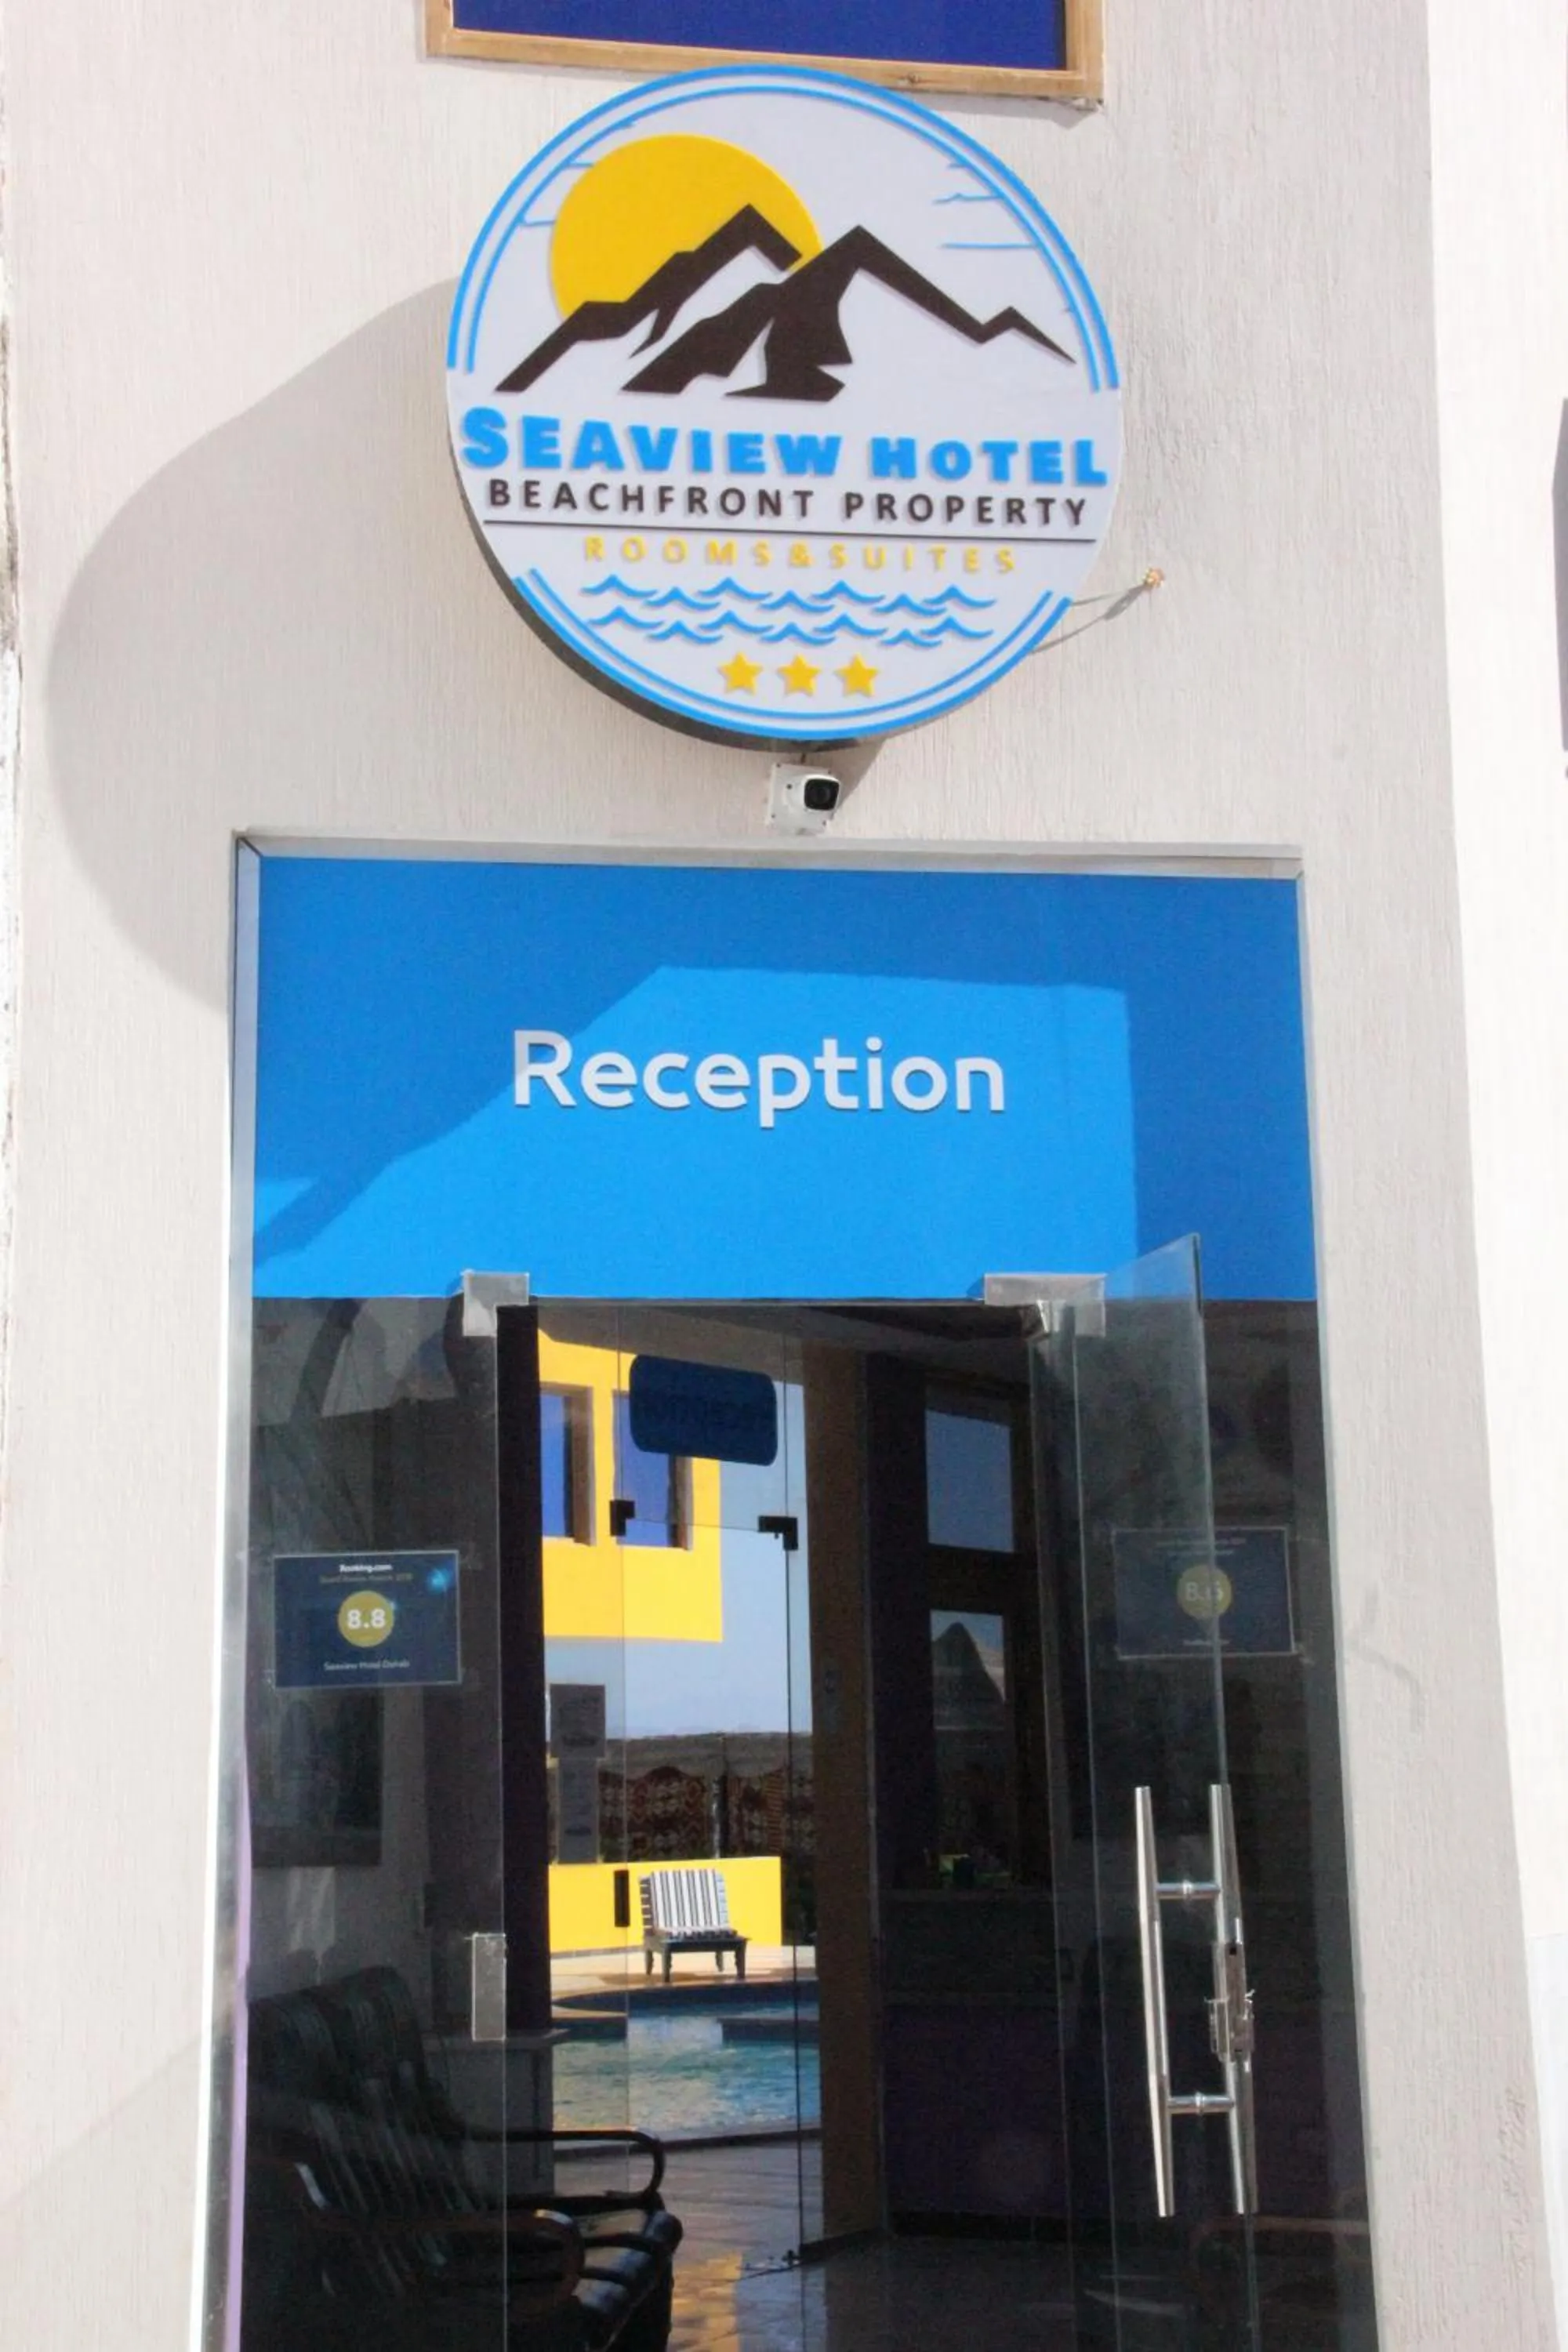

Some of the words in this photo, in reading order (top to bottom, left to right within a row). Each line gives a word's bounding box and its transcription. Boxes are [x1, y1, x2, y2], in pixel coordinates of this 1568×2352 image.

[461, 405, 843, 477] SEAVIEW
[870, 435, 1109, 486] HOTEL
[488, 479, 814, 517] BEACHFRONT
[844, 492, 1086, 525] PROPERTY
[514, 1029, 1004, 1127] Reception
[347, 1608, 386, 1630] 8.8
